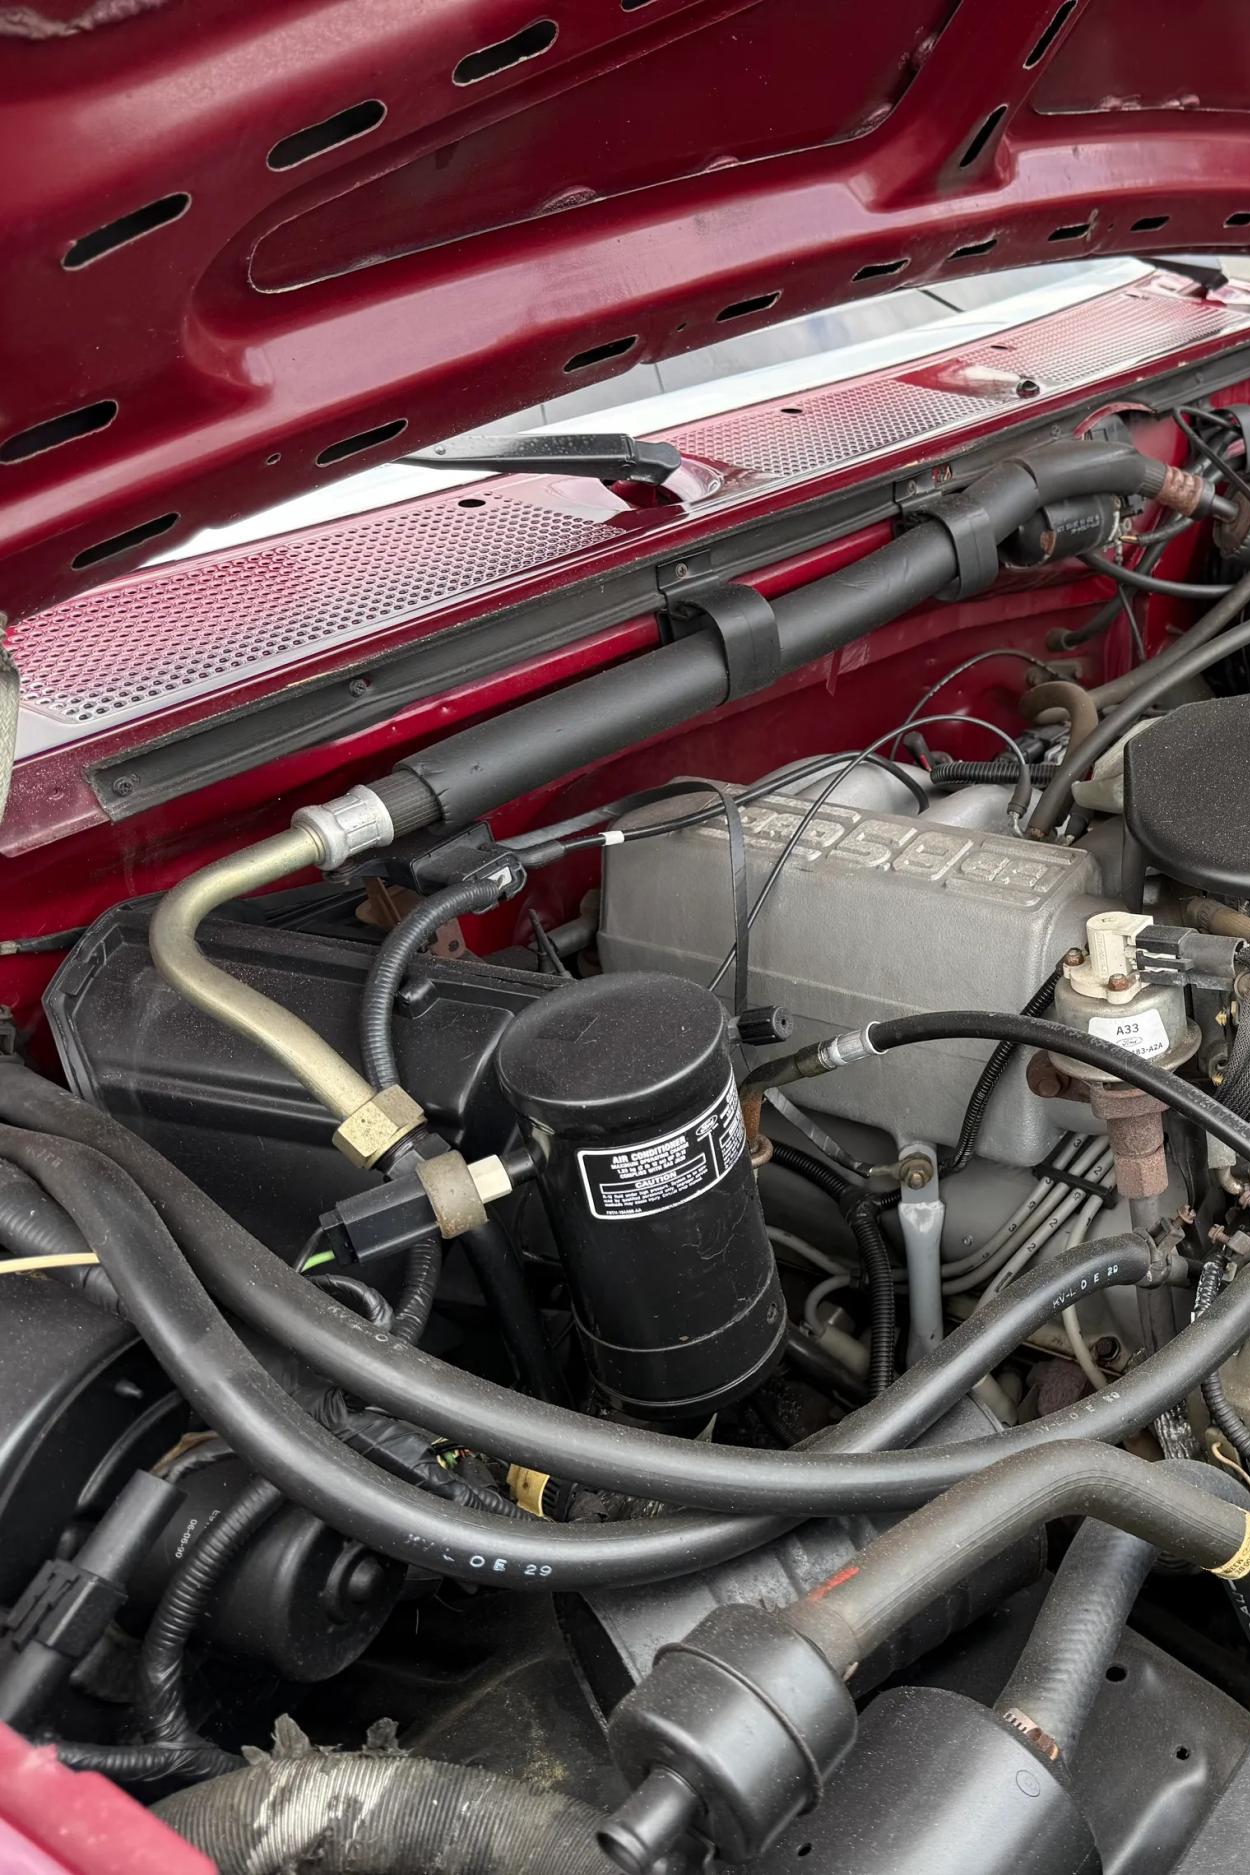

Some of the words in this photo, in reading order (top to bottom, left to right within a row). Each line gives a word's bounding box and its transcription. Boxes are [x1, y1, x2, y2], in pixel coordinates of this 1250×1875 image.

[1116, 1023, 1139, 1036] A33
[612, 1154, 629, 1164] AIR
[631, 1135, 686, 1161] CONDITIONER
[635, 1170, 677, 1189] CAUTION
[523, 1564, 553, 1577] 29
